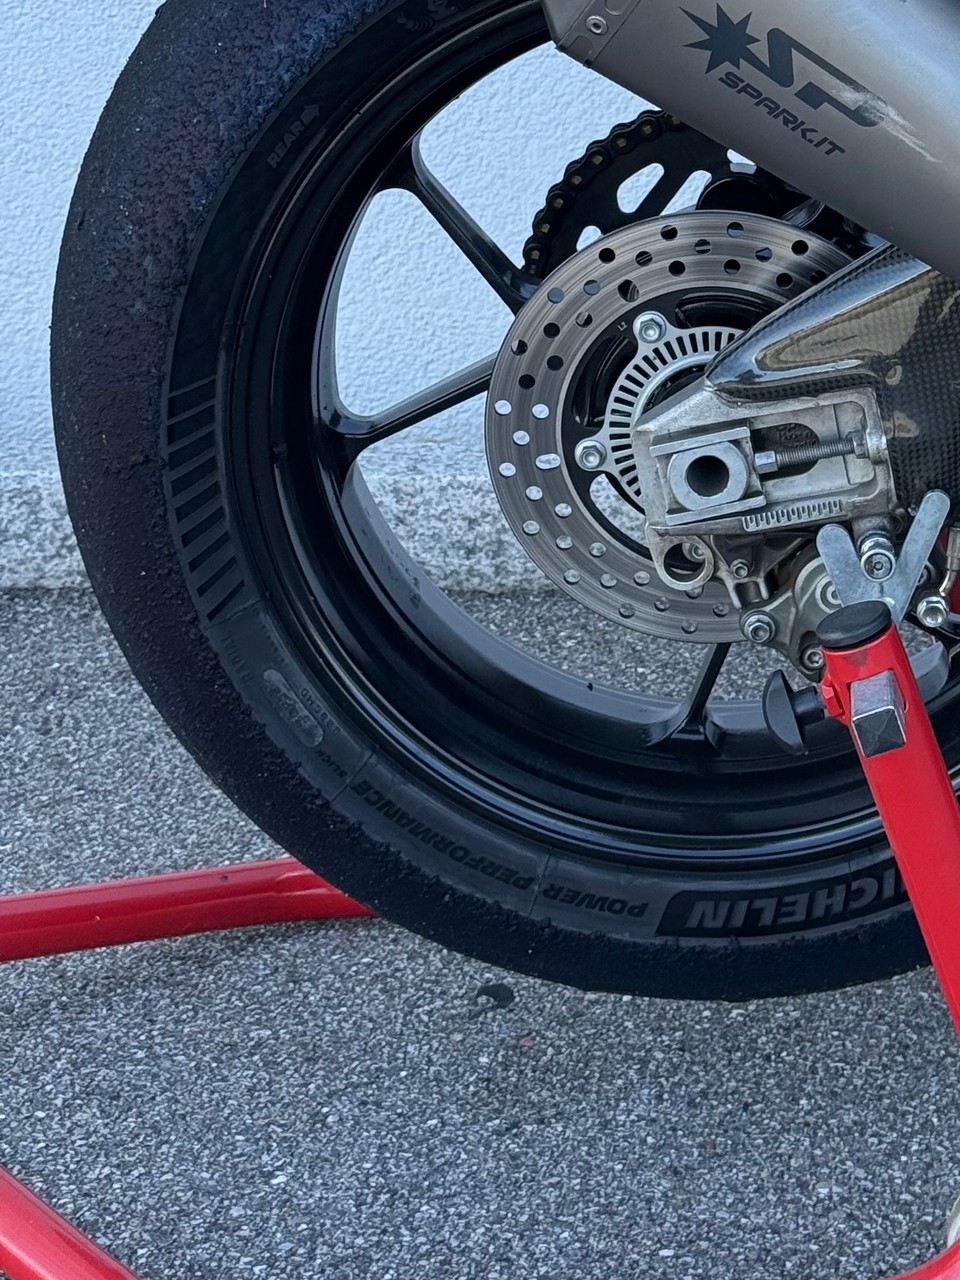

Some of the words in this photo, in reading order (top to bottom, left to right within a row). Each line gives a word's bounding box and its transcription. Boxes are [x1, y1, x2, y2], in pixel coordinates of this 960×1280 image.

[718, 71, 847, 156] SPARK.IT
[266, 121, 304, 168] REAR
[314, 749, 348, 778] SLICK
[350, 778, 537, 891] PERFORMANCE
[542, 881, 649, 918] POWER
[685, 867, 907, 929] ICHELIN
